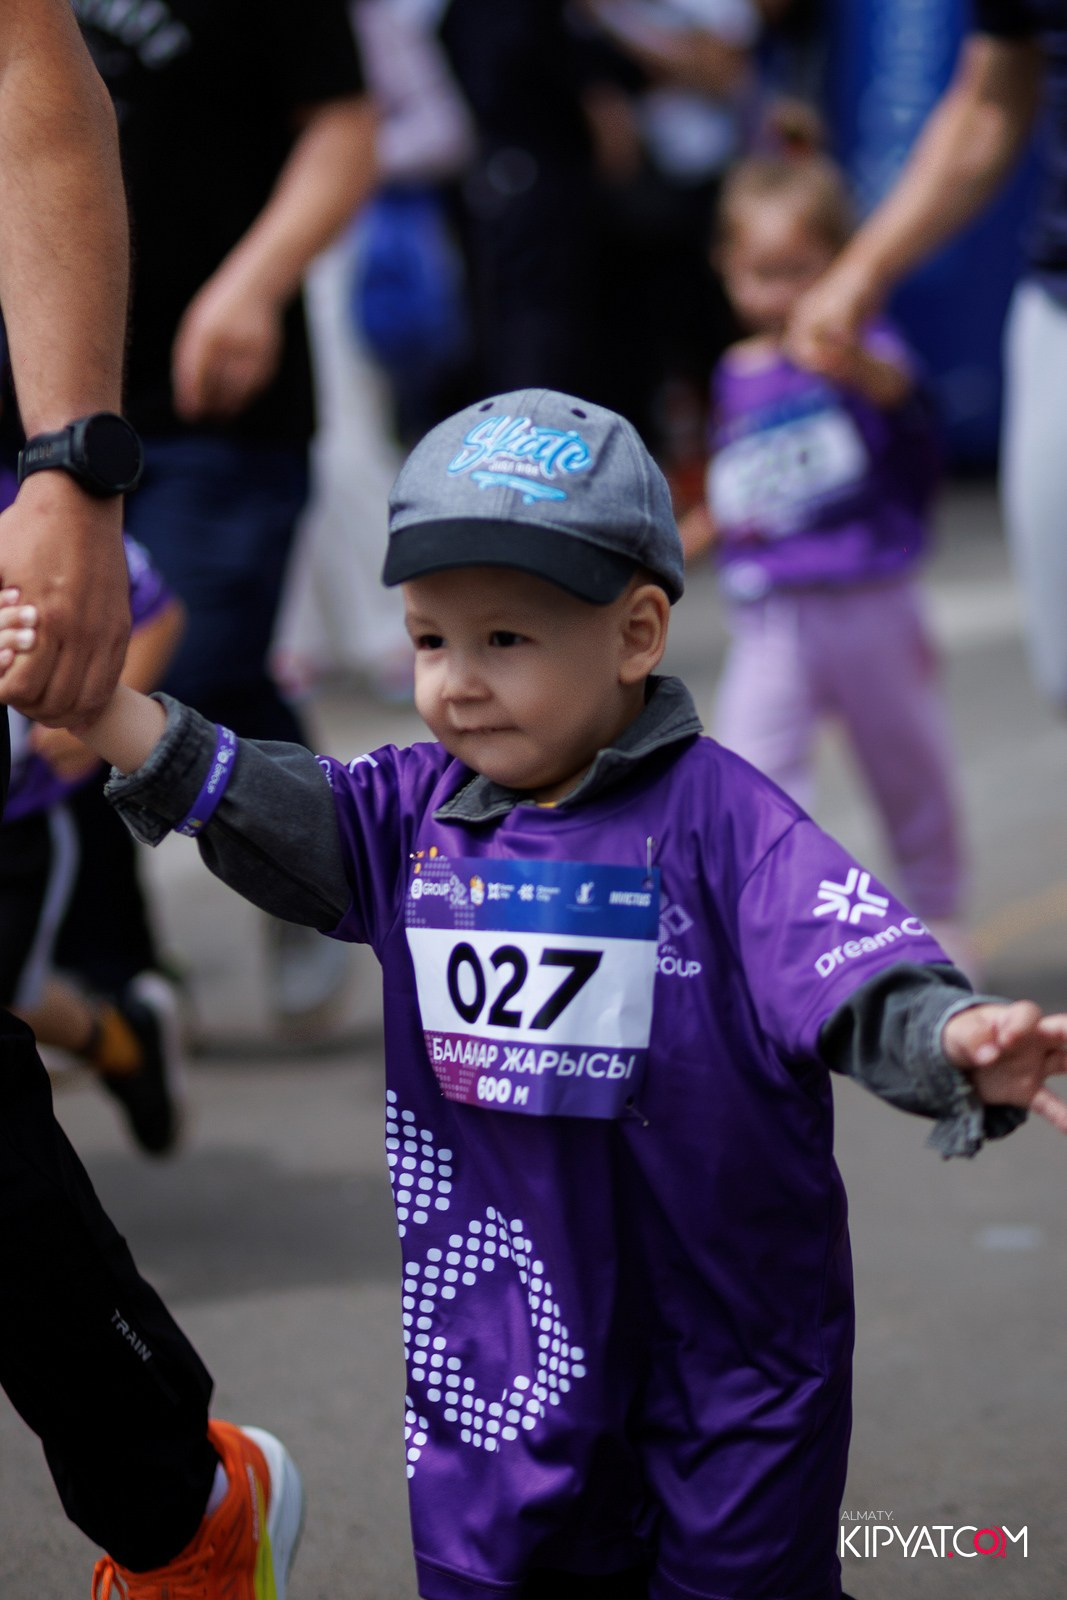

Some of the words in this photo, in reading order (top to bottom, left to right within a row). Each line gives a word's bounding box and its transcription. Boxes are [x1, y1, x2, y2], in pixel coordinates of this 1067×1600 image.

[814, 925, 902, 978] Dream
[447, 942, 604, 1031] 027
[500, 1046, 636, 1079] ЖАРЫСЫ
[477, 1075, 512, 1104] 600
[111, 1308, 152, 1362] TRAIN
